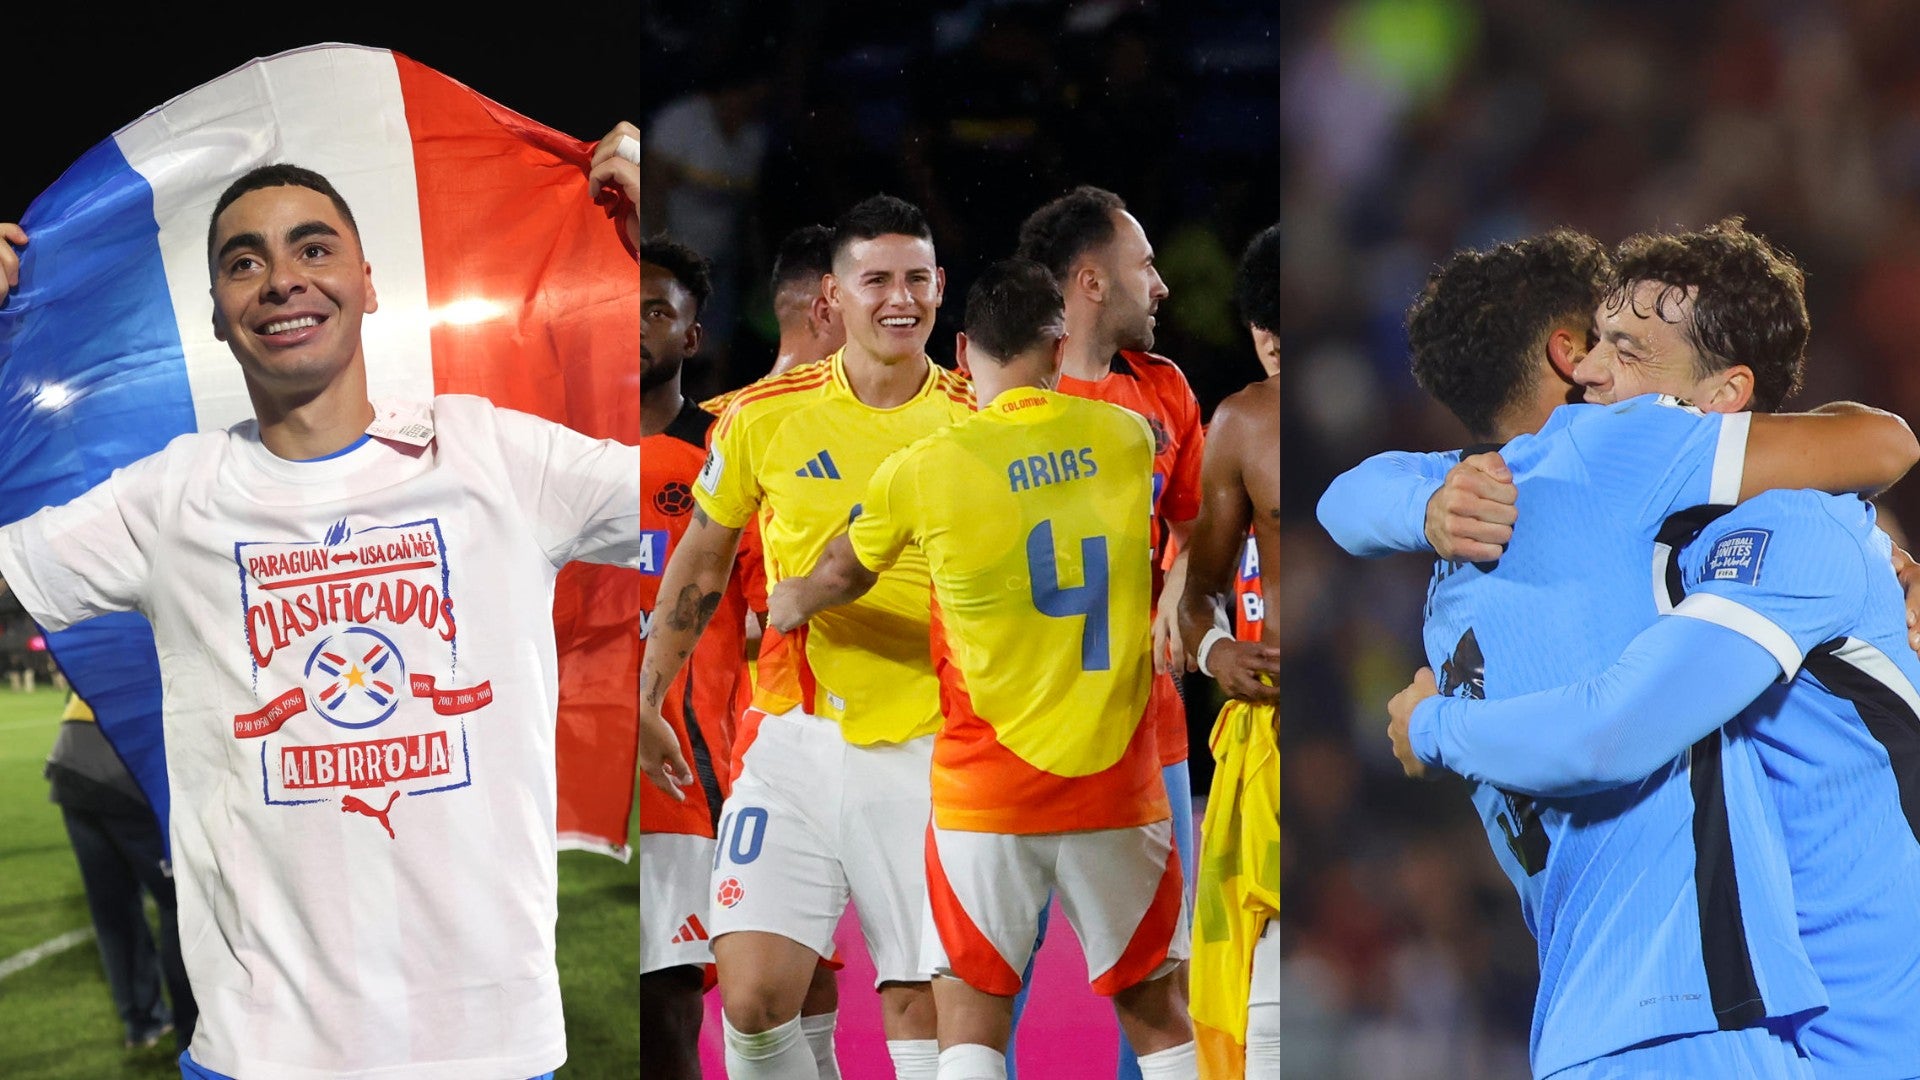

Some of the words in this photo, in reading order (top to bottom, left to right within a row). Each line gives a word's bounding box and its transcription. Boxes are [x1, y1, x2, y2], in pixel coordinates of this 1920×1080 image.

[1008, 447, 1098, 492] ARIAS
[400, 531, 432, 543] 2026
[1718, 537, 1754, 547] FOOTBALL
[249, 548, 330, 578] PARAGUAY
[359, 546, 387, 565] USA
[387, 542, 411, 562] CAN
[412, 540, 436, 557] MEX
[1026, 519, 1111, 671] 4
[247, 579, 456, 668] CLASIFICADOS
[413, 681, 430, 691] 1998
[235, 721, 253, 732] 1930
[254, 716, 270, 730] 1950
[267, 706, 283, 722] 1958
[282, 695, 302, 710] 1986
[283, 735, 450, 786] ALBIRROJA
[714, 807, 769, 871] 10
